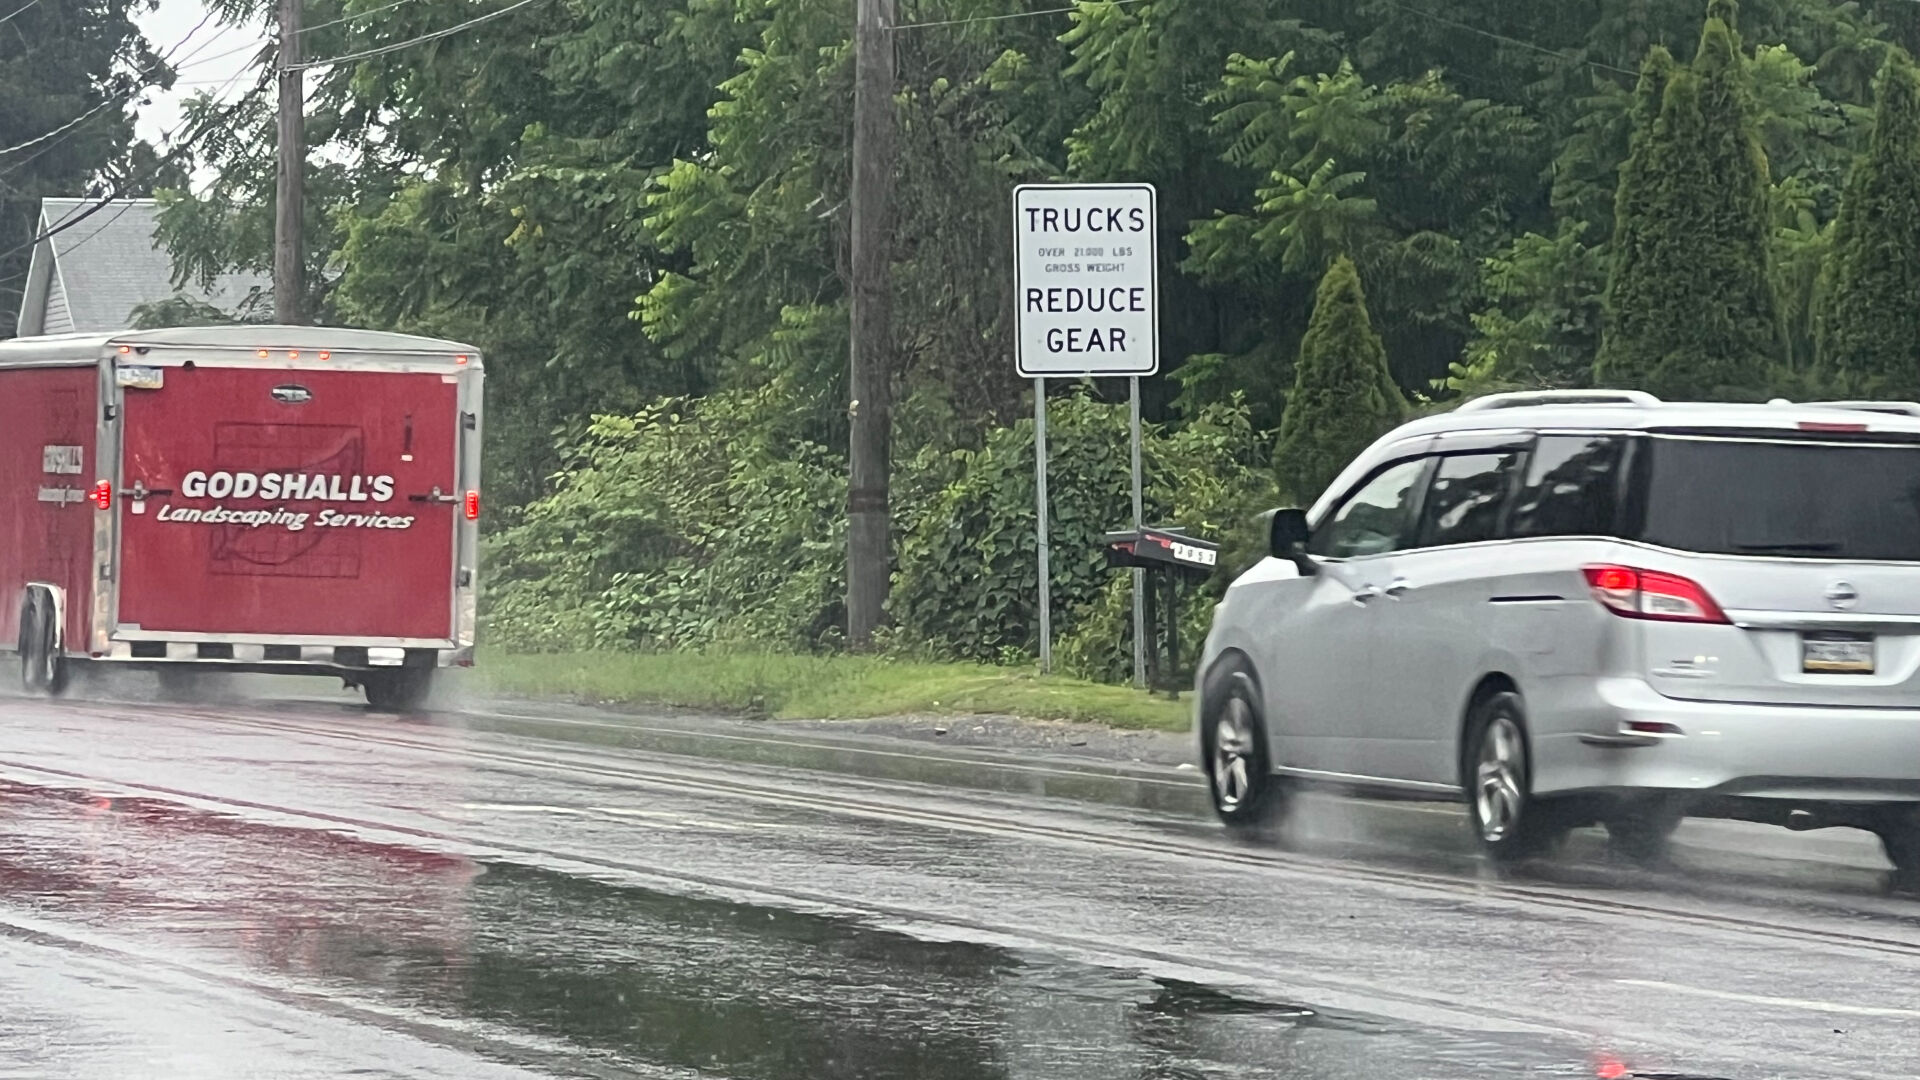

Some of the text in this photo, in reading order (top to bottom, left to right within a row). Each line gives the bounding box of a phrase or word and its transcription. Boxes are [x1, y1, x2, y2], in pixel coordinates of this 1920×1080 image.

[1025, 208, 1145, 232] TRUCKS
[1038, 247, 1065, 257] OVER
[1112, 247, 1133, 257] LBS
[1045, 263, 1125, 273] GROSS WEIGHT
[1027, 287, 1146, 313] REDUCE
[1046, 328, 1127, 353] GEAR
[181, 470, 395, 502] GODSHALL'S
[156, 504, 415, 531] Landscaping Services
